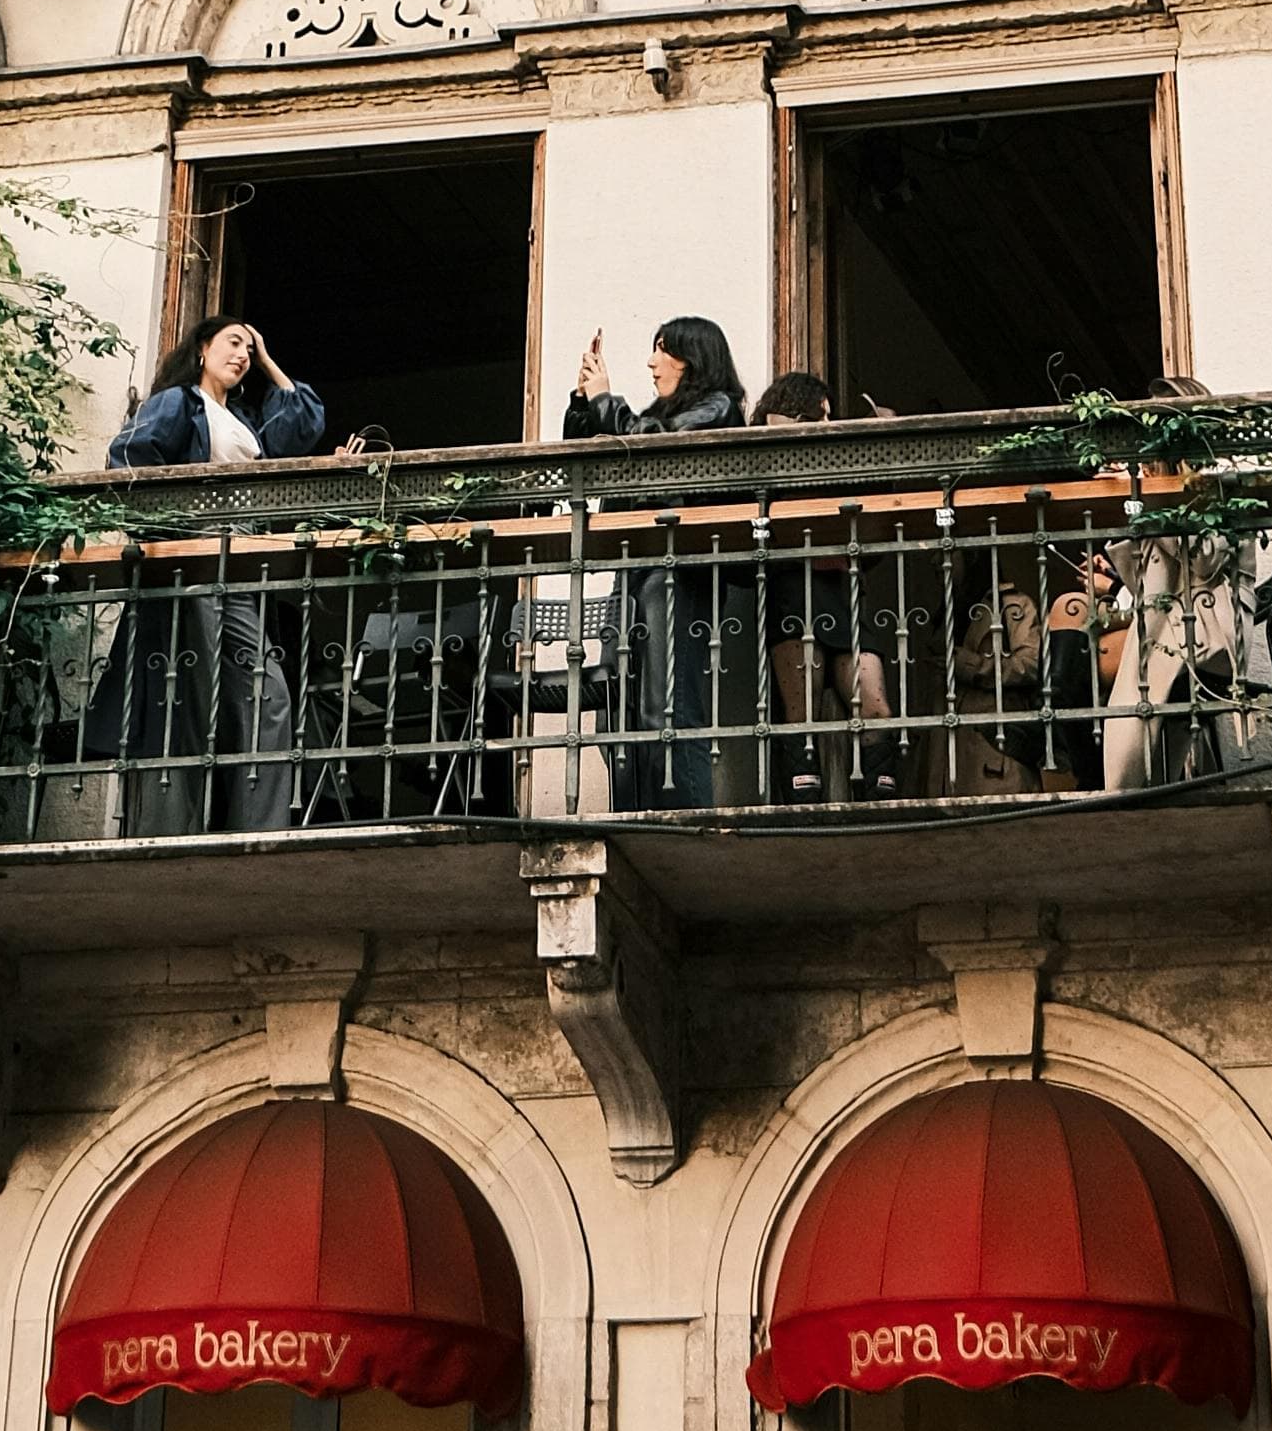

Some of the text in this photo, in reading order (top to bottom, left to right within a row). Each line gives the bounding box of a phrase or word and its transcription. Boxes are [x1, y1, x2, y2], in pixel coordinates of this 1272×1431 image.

[103, 1320, 351, 1385] pera bakery
[848, 1312, 1118, 1376] pera bakery
